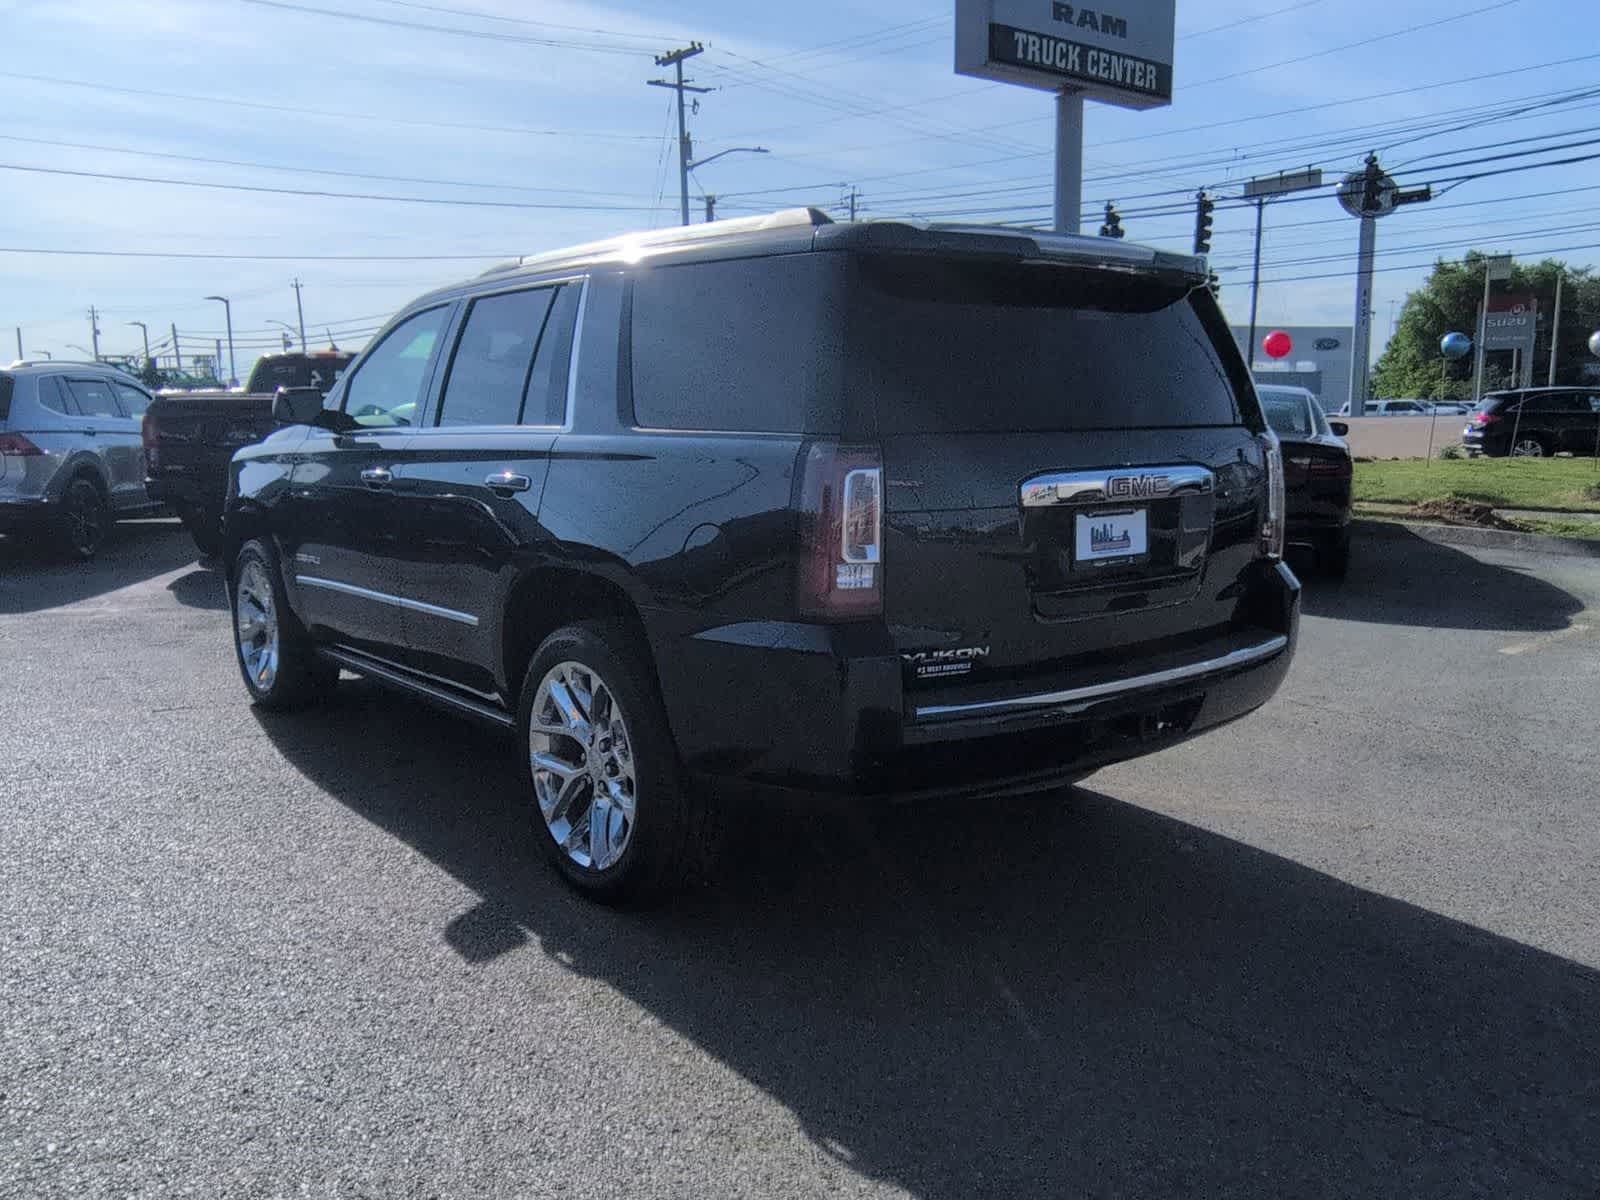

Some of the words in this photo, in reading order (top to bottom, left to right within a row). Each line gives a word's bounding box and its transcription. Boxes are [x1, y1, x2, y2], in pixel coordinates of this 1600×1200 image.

[1052, 2, 1127, 38] RAM
[1014, 32, 1081, 72] TRUCK
[1087, 49, 1156, 90] CENTER
[1108, 474, 1169, 498] GMC
[901, 645, 990, 662] YUKON
